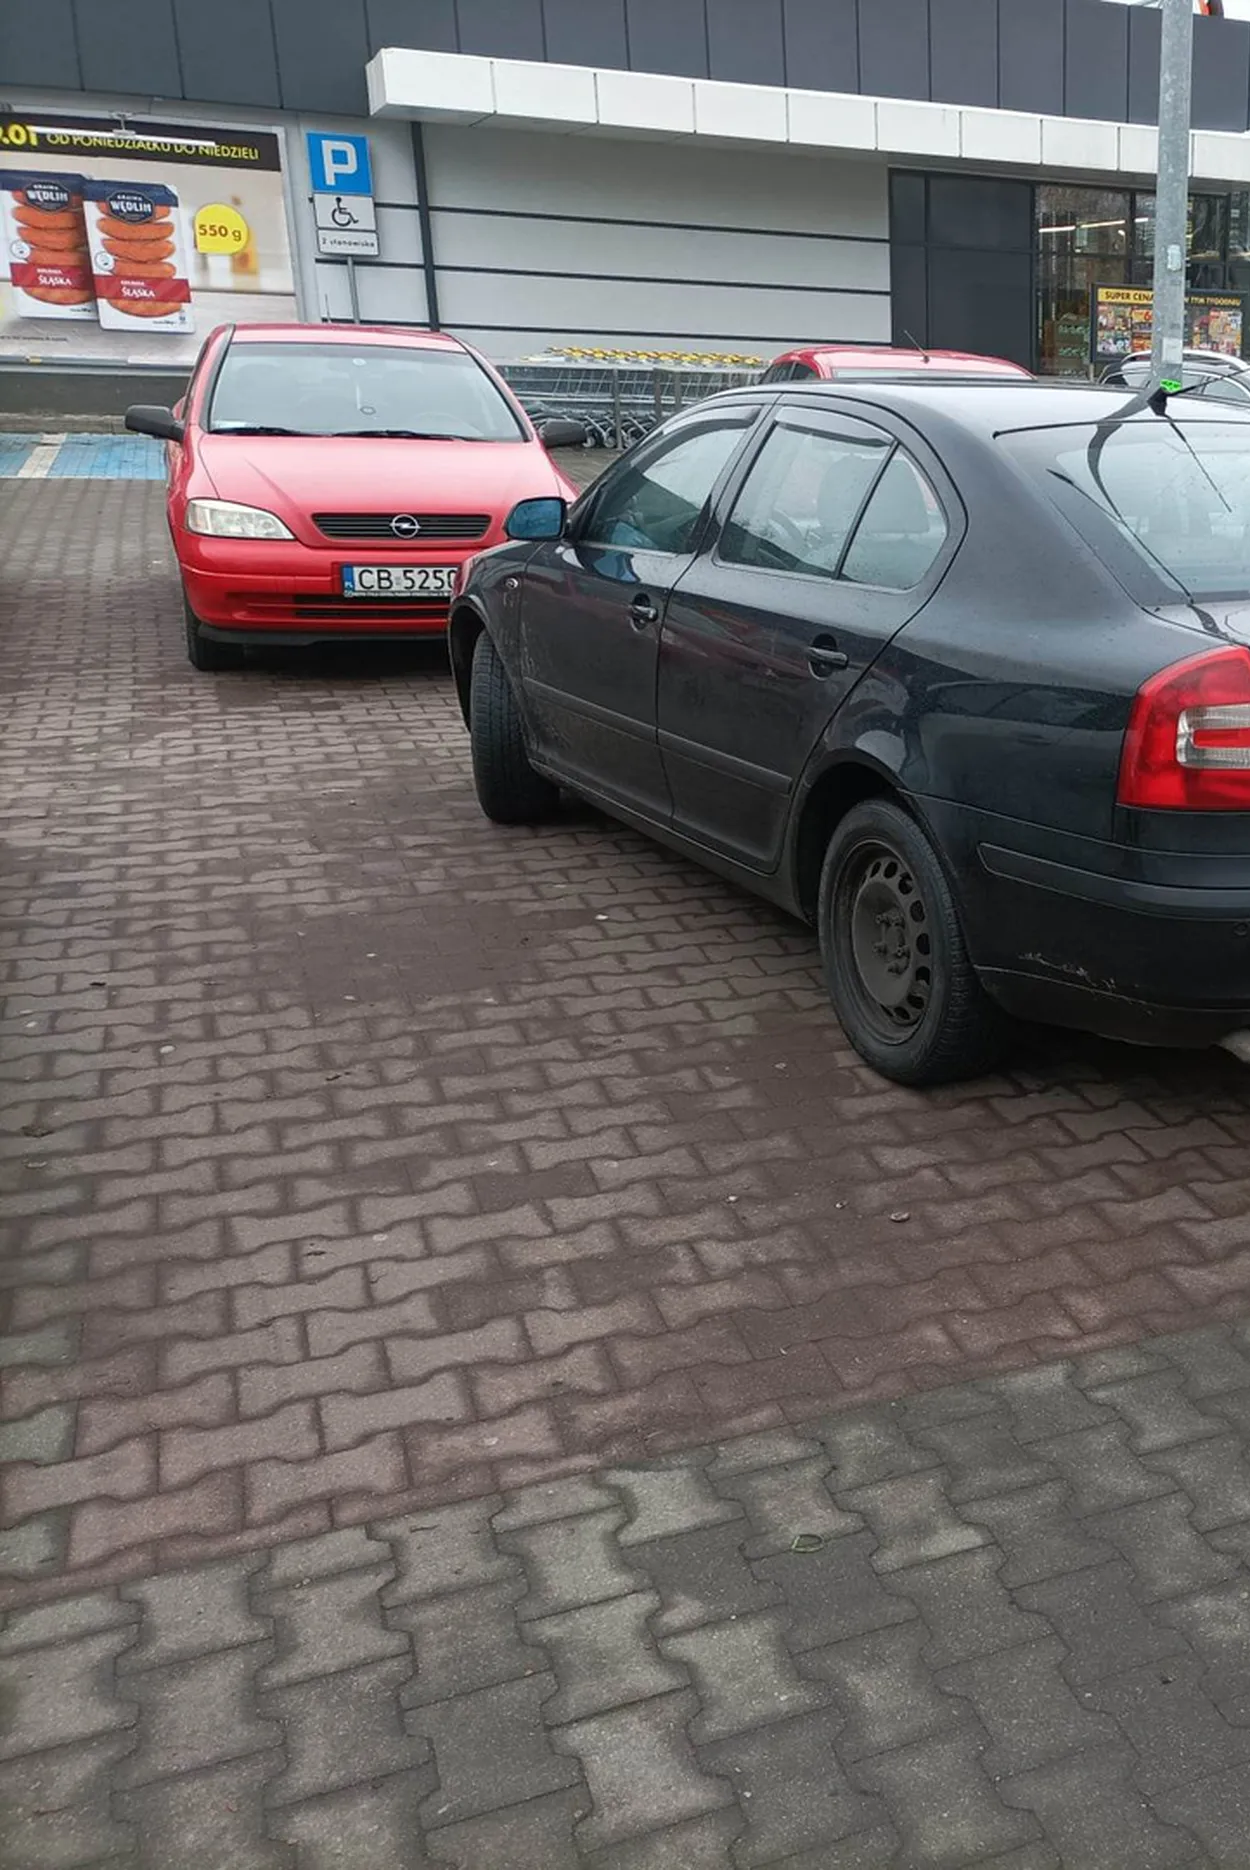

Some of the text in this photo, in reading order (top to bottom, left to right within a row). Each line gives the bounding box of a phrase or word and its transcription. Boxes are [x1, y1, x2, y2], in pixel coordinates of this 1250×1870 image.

[0, 123, 38, 146] .01
[46, 132, 70, 145] OD
[174, 143, 196, 154] DO
[199, 145, 259, 159] NIEDZIELI
[321, 139, 358, 186] P
[198, 224, 242, 242] 550 g
[1105, 290, 1131, 301] SUPER
[358, 569, 394, 590] CB
